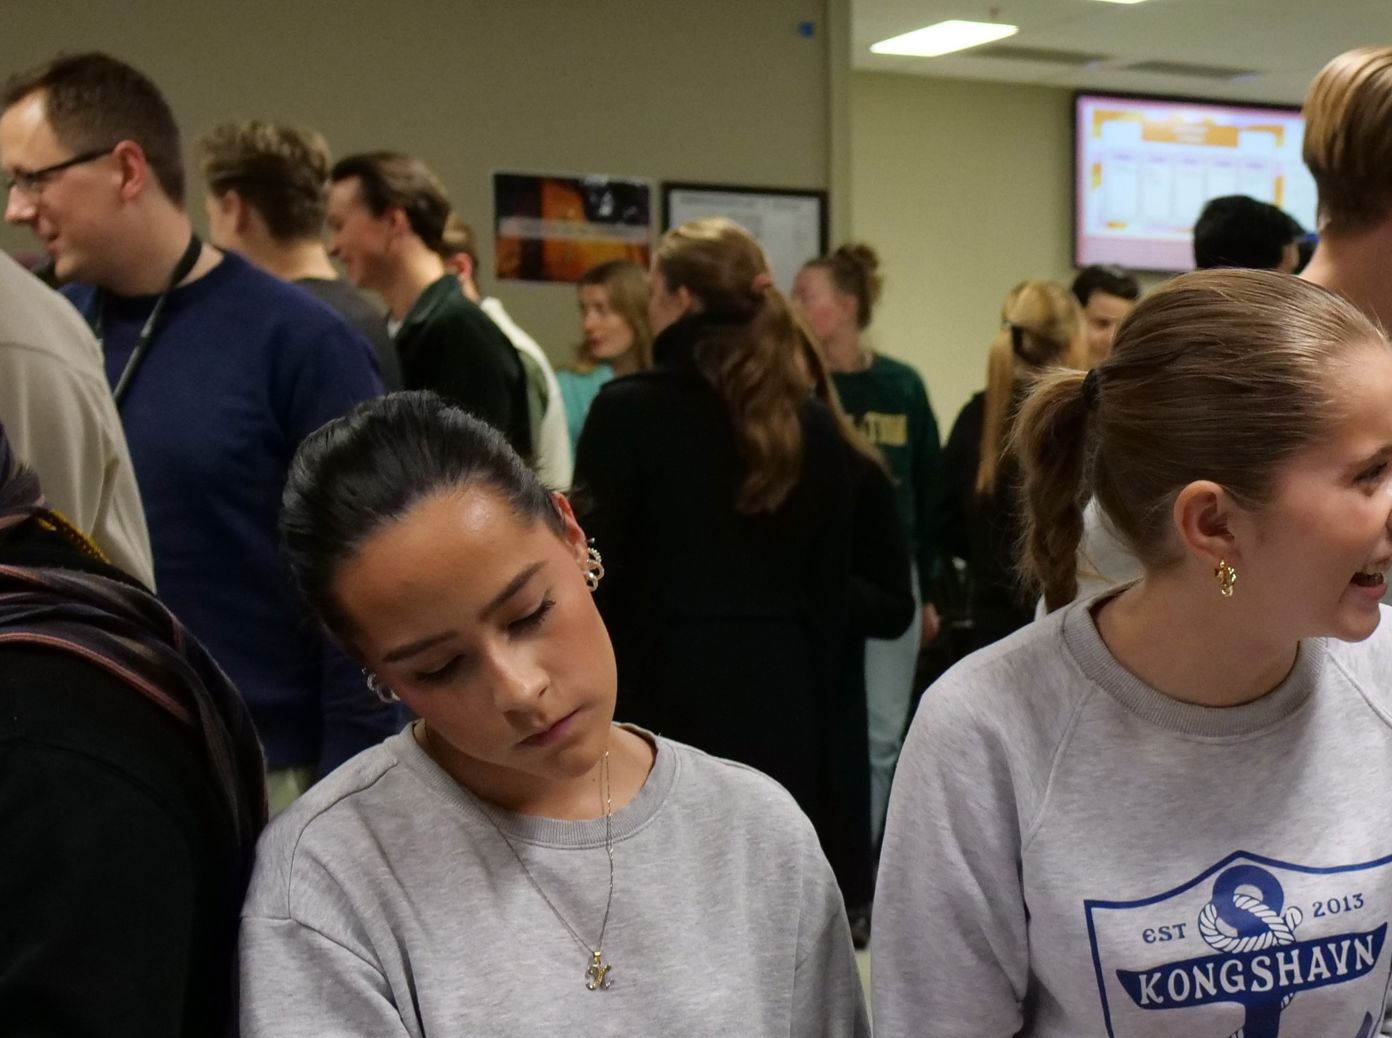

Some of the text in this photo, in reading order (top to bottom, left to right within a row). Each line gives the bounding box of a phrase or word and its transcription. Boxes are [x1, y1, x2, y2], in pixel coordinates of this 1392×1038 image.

[1142, 893, 1365, 944] EST 2013
[1138, 934, 1375, 1005] KONGSHAVN
